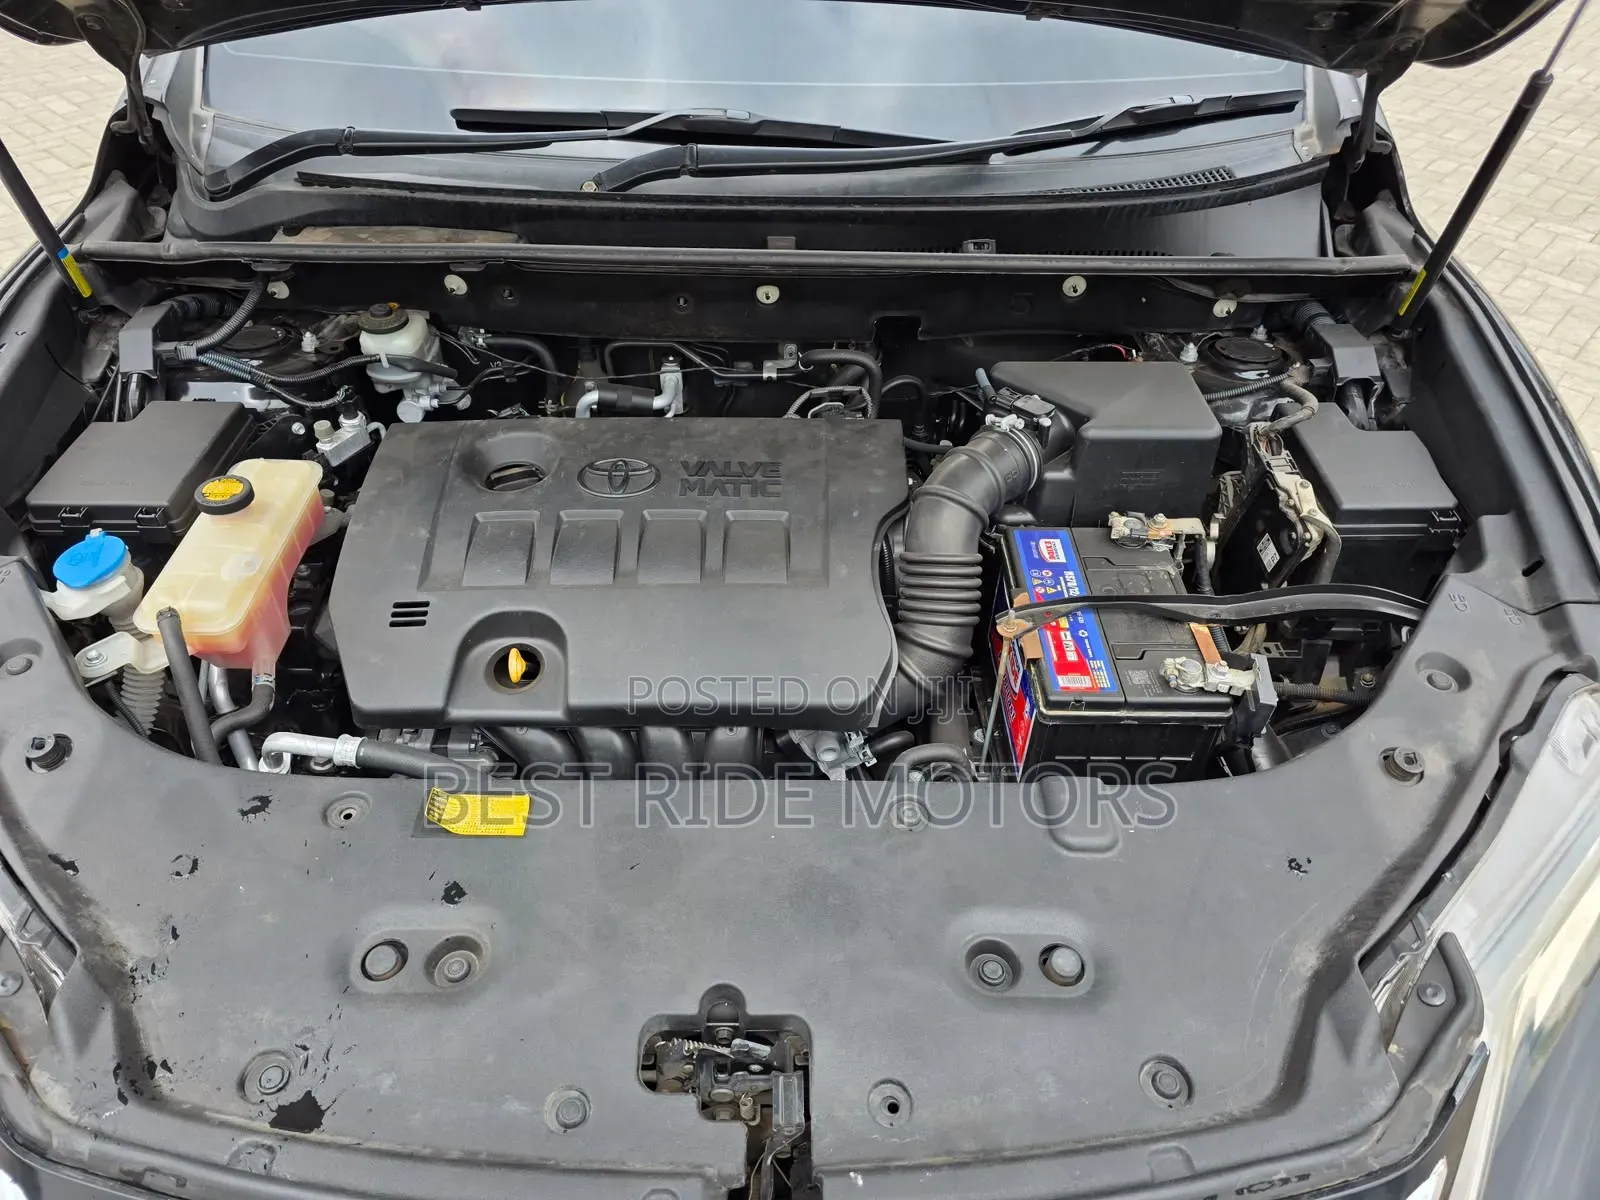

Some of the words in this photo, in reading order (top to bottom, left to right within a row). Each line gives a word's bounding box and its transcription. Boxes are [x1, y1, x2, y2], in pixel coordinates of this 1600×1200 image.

[679, 460, 783, 478] VALVE
[678, 479, 783, 498] MATIC
[1044, 540, 1057, 561] EXIDE
